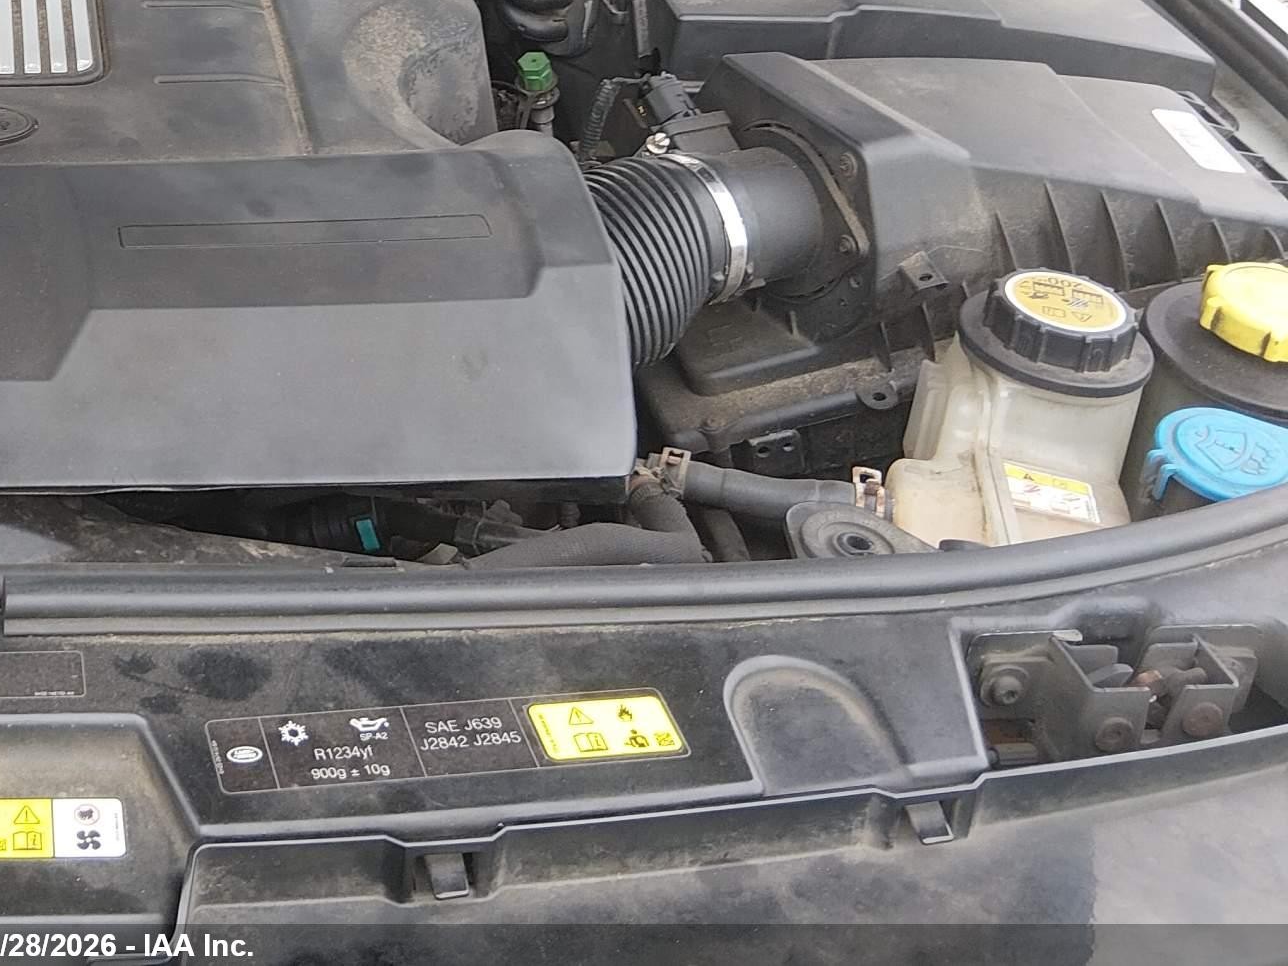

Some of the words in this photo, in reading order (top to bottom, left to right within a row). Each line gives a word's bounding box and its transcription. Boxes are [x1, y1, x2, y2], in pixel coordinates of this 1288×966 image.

[424, 719, 460, 733] SAE
[464, 716, 503, 731] J639
[359, 733, 389, 741] SP-A2
[420, 735, 470, 751] J2842
[473, 731, 522, 746] J2845
[313, 744, 375, 761] R1234yf
[311, 767, 348, 780] 900g
[350, 768, 361, 777] ±
[364, 764, 390, 777] 10g
